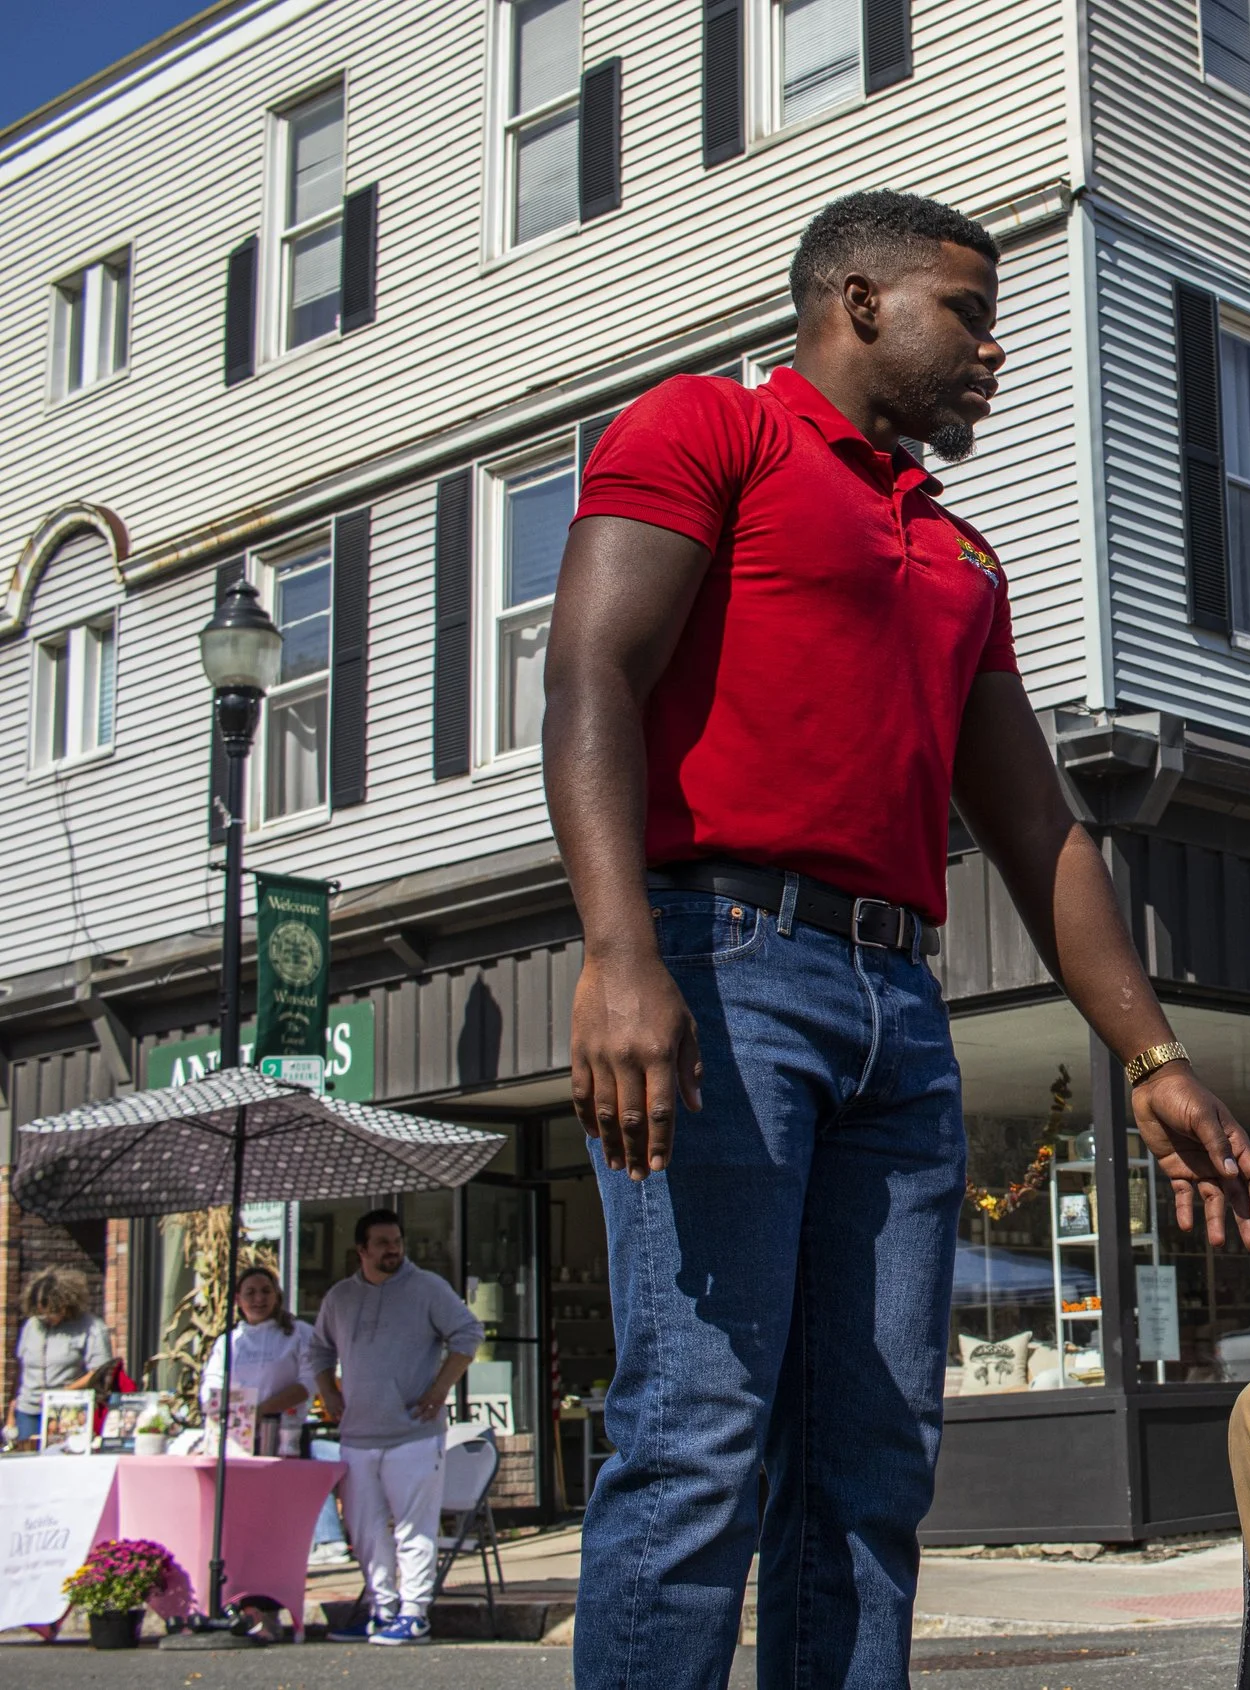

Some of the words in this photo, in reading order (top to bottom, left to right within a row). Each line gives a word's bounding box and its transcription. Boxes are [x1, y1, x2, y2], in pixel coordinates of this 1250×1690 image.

[268, 895, 320, 915] Welcome
[273, 989, 318, 1008] Winsted
[268, 1063, 277, 1076] 2
[283, 1071, 318, 1080] PARKING
